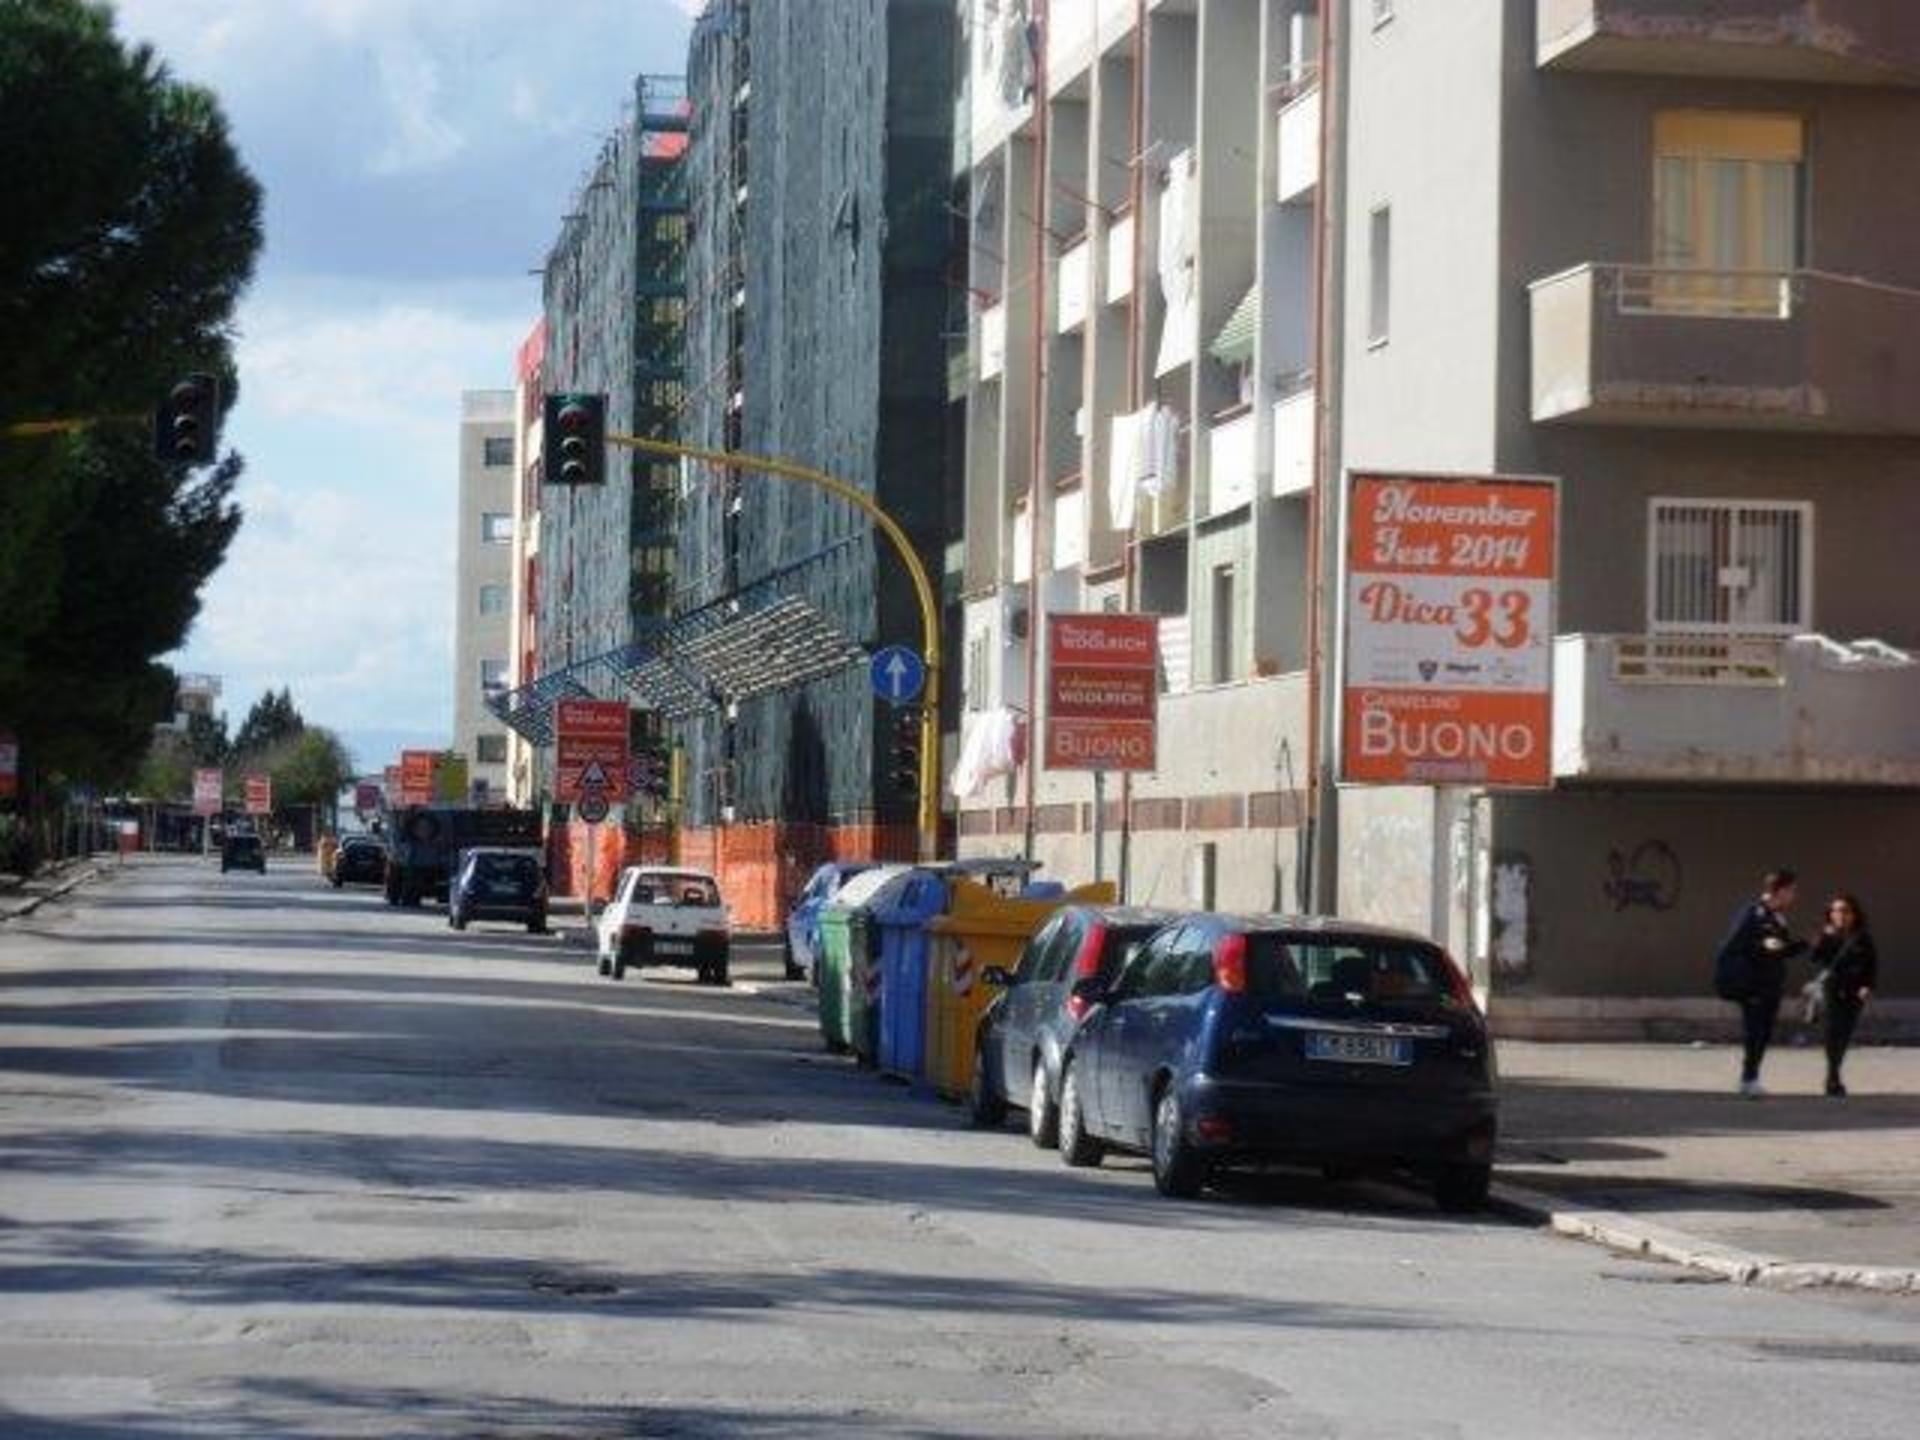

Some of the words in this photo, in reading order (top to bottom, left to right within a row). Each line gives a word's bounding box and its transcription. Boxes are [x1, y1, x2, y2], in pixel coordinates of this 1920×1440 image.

[1373, 485, 1536, 526] November
[1448, 533, 1529, 570] 2014
[1359, 581, 1456, 625] Dica
[1455, 588, 1532, 650] 33
[1061, 636, 1147, 651] WOOLRICH
[1058, 690, 1144, 706] WOOLRICH
[1055, 731, 1146, 757] BUONO
[1360, 710, 1534, 760] BUONO
